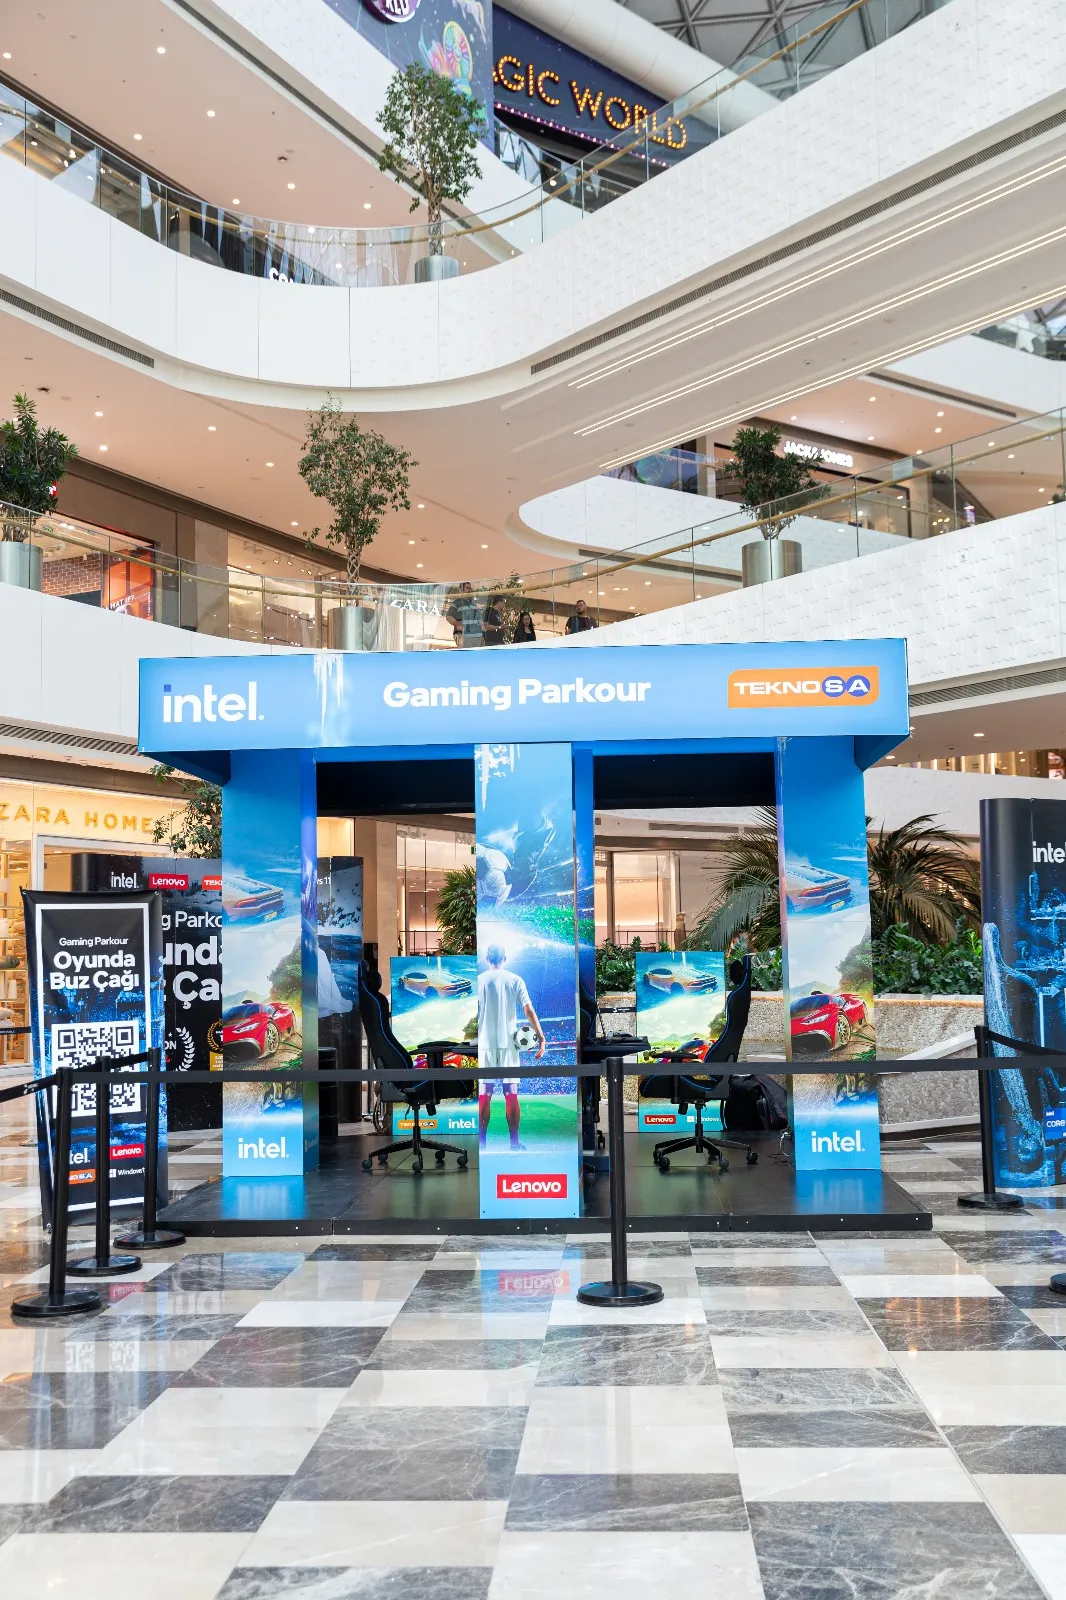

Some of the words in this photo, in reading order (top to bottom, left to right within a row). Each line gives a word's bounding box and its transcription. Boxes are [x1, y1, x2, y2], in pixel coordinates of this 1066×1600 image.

[493, 55, 560, 107] GIC
[569, 80, 687, 149] WORLD
[390, 594, 442, 616] ZARA
[383, 680, 512, 711] Gaming
[518, 677, 652, 705] Parkour
[734, 677, 870, 696] TEKNOSA
[0, 802, 70, 825] ZARA
[85, 811, 153, 834] HOME
[1032, 841, 1066, 864] inte
[152, 876, 186, 887] Lenovo
[59, 937, 94, 947] Gaming
[94, 936, 129, 946] Parkour
[53, 950, 136, 972] Oyunda
[50, 972, 91, 990] Buz
[92, 969, 140, 993] Çağı
[173, 970, 222, 1010] Ça
[112, 1147, 142, 1157] Lenovo
[502, 1179, 562, 1193] Lenovo
